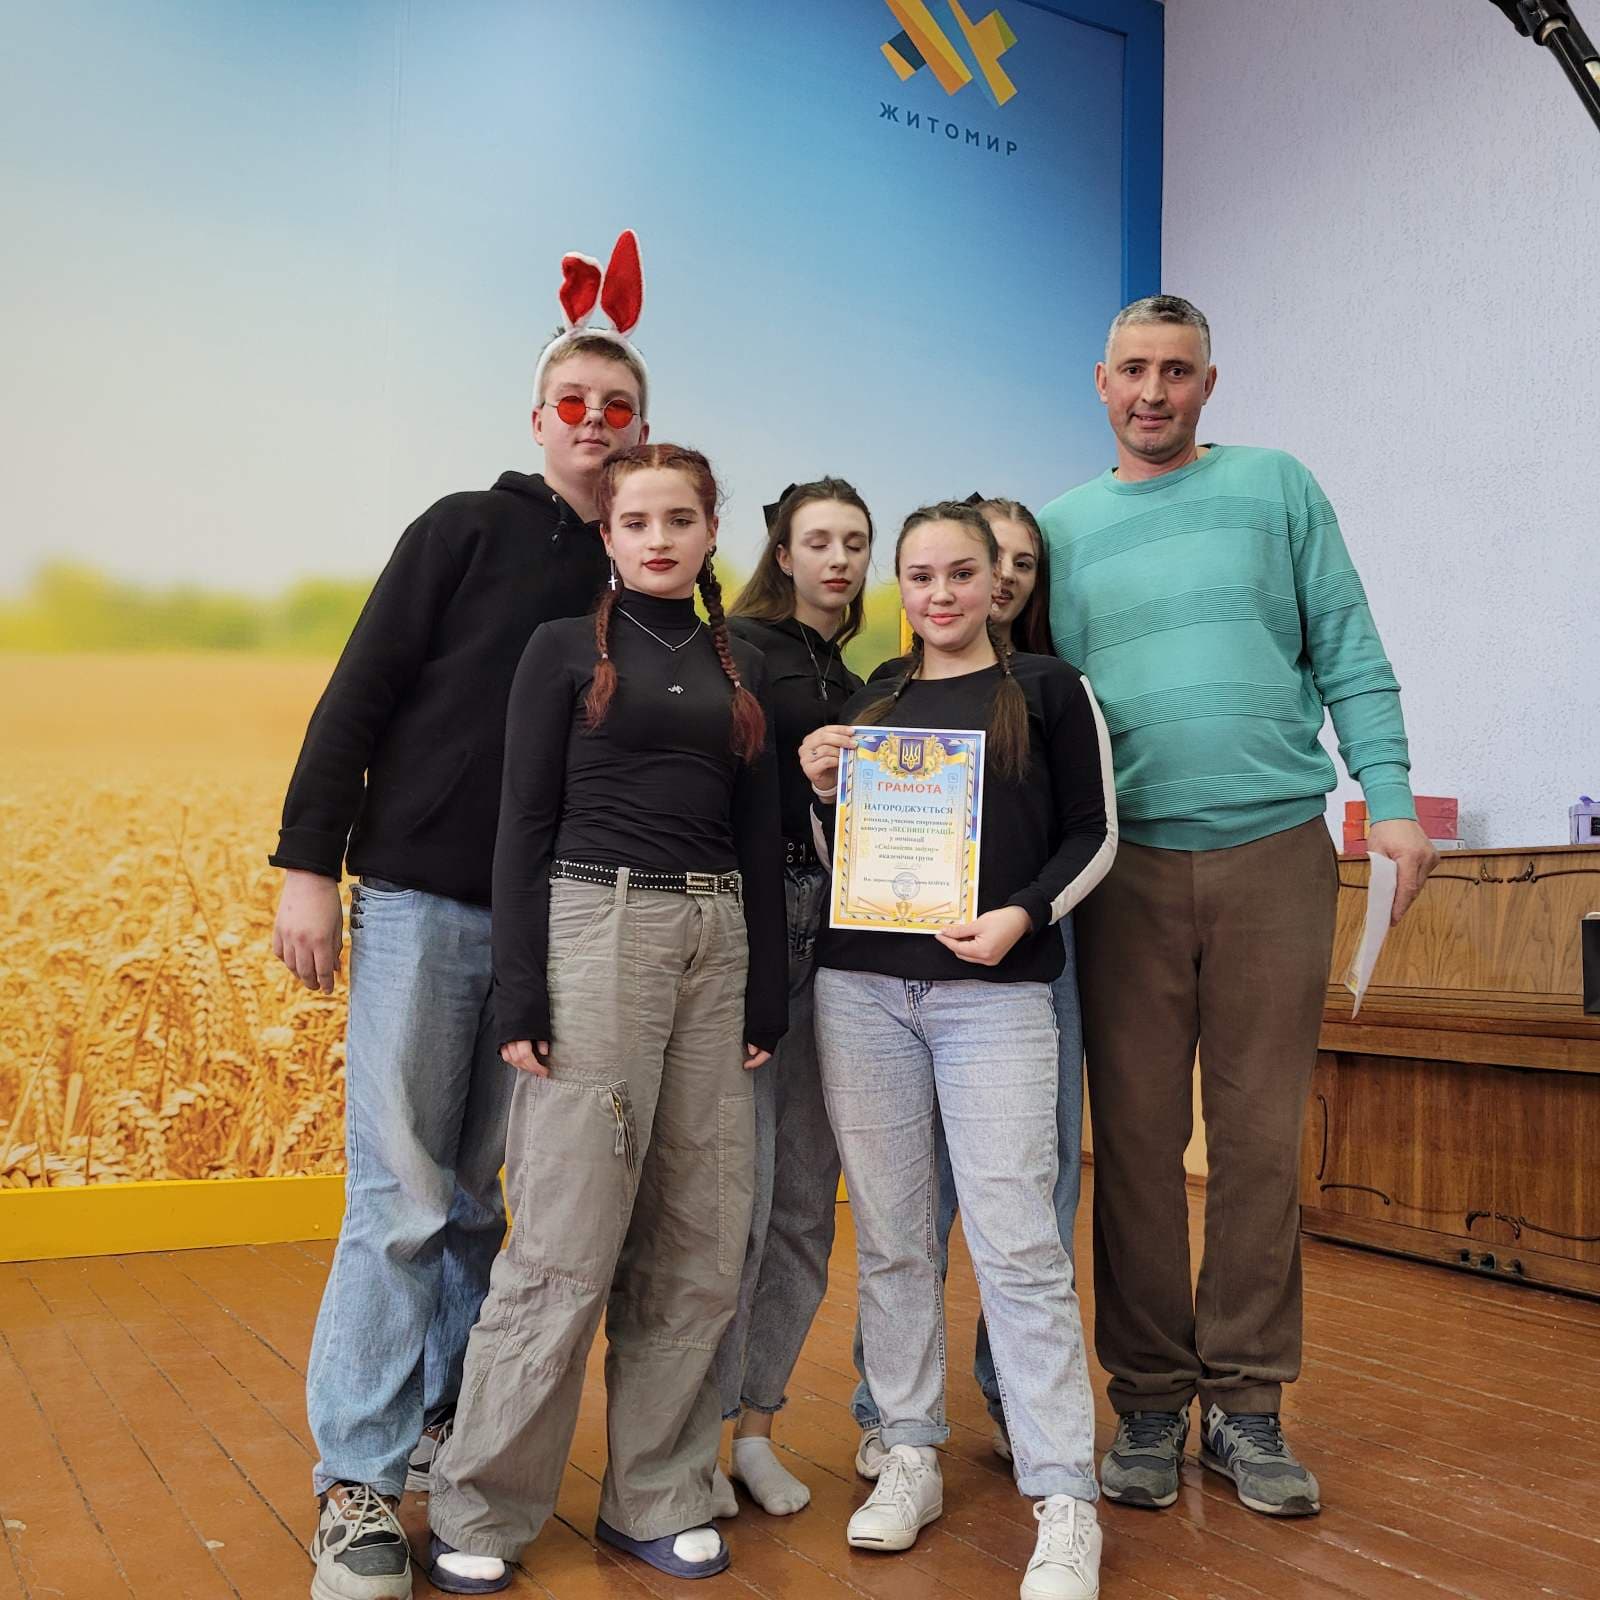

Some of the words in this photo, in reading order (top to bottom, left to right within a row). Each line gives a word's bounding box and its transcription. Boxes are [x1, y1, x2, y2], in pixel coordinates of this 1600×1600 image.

[879, 102, 1018, 156] ЖИТОМИР
[877, 781, 942, 794] ГРАМОТА
[864, 802, 953, 815] НАГОРОДЖУЄТЬСЯ
